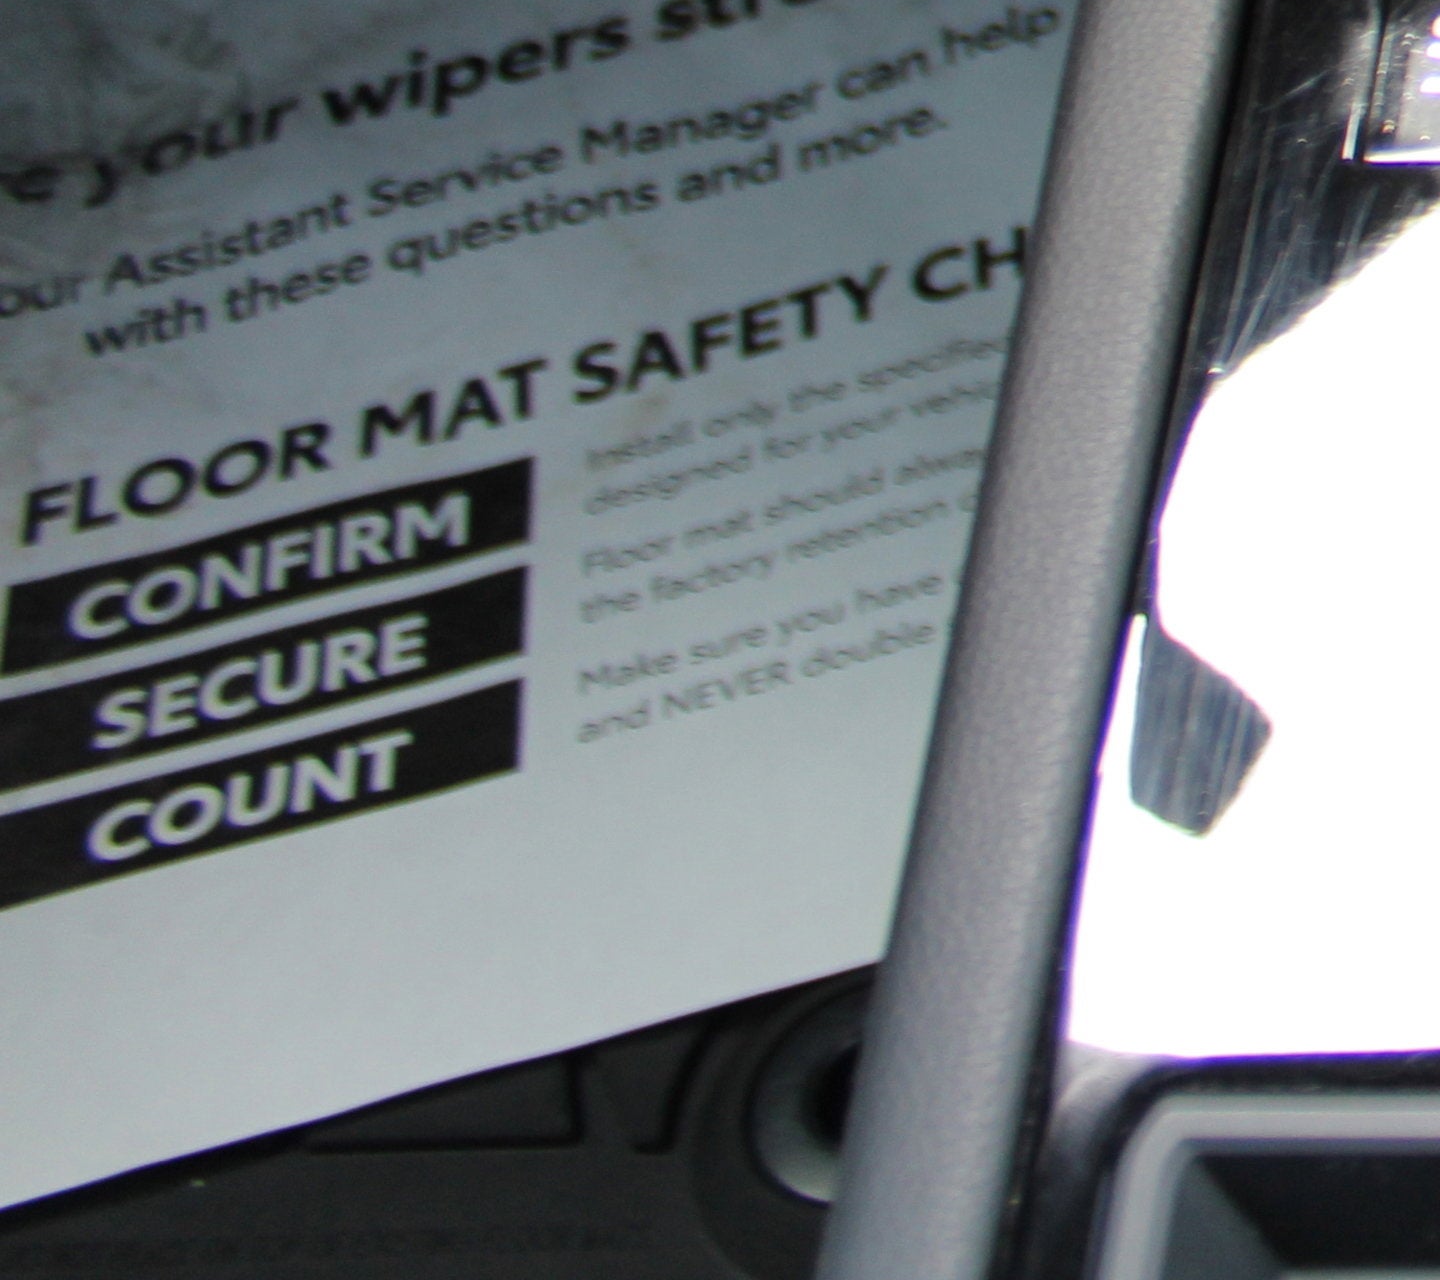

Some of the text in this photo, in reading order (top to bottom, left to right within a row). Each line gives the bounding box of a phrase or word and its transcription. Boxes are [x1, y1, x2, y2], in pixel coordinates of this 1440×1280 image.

[0, 1, 1062, 320] our Assistant Service Manager can help
[80, 91, 300, 207] your
[323, 13, 630, 129] wipers
[84, 107, 950, 358] with these questions and more.
[20, 422, 333, 547] FLOOR
[358, 359, 549, 458] MAT
[571, 265, 891, 406] SAFETY
[911, 227, 1030, 303] CH
[586, 380, 848, 472] Install only the
[581, 534, 674, 578] Floor
[685, 510, 753, 546] mat
[763, 464, 885, 525] should
[585, 406, 899, 516] designed for your
[67, 491, 470, 643] CONFIRM
[580, 590, 642, 624] the
[650, 550, 776, 603] factory
[787, 497, 947, 562] retention
[91, 613, 429, 752] SECURE
[578, 622, 937, 743] and NEVER double
[579, 573, 943, 694] Make sure you have
[86, 733, 413, 866] COUNT
